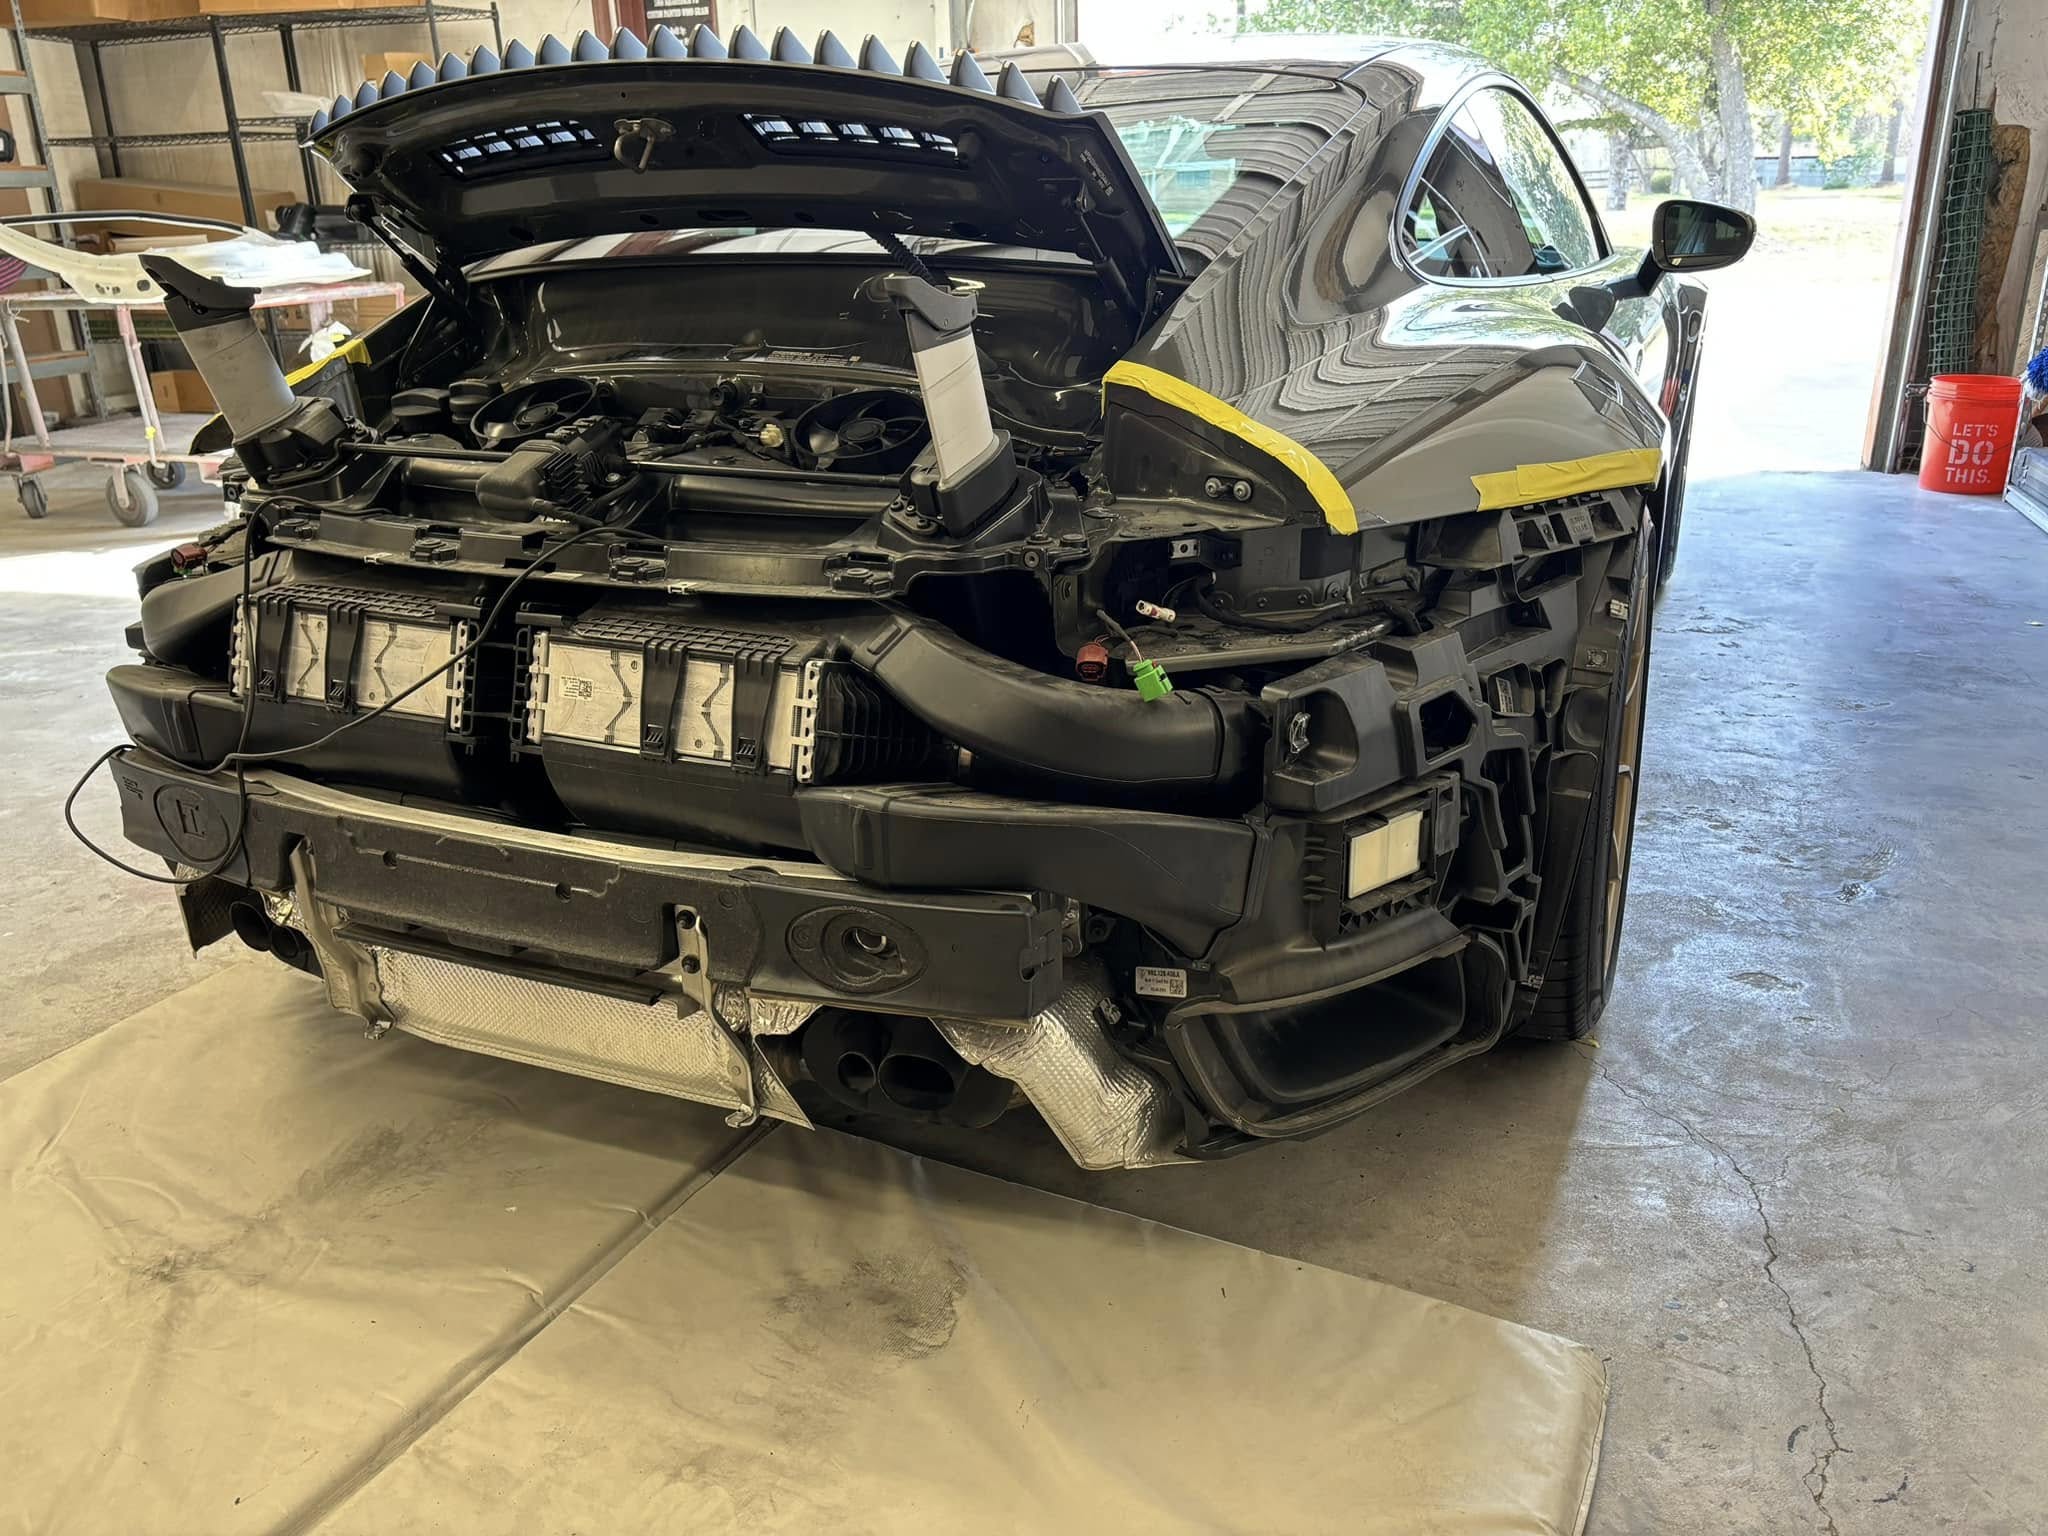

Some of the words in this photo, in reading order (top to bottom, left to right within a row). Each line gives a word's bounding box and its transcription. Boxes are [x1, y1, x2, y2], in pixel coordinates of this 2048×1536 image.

[1952, 422, 1999, 437] LET'S
[1947, 439, 1994, 466] DO
[1944, 466, 1991, 484] THIS.
